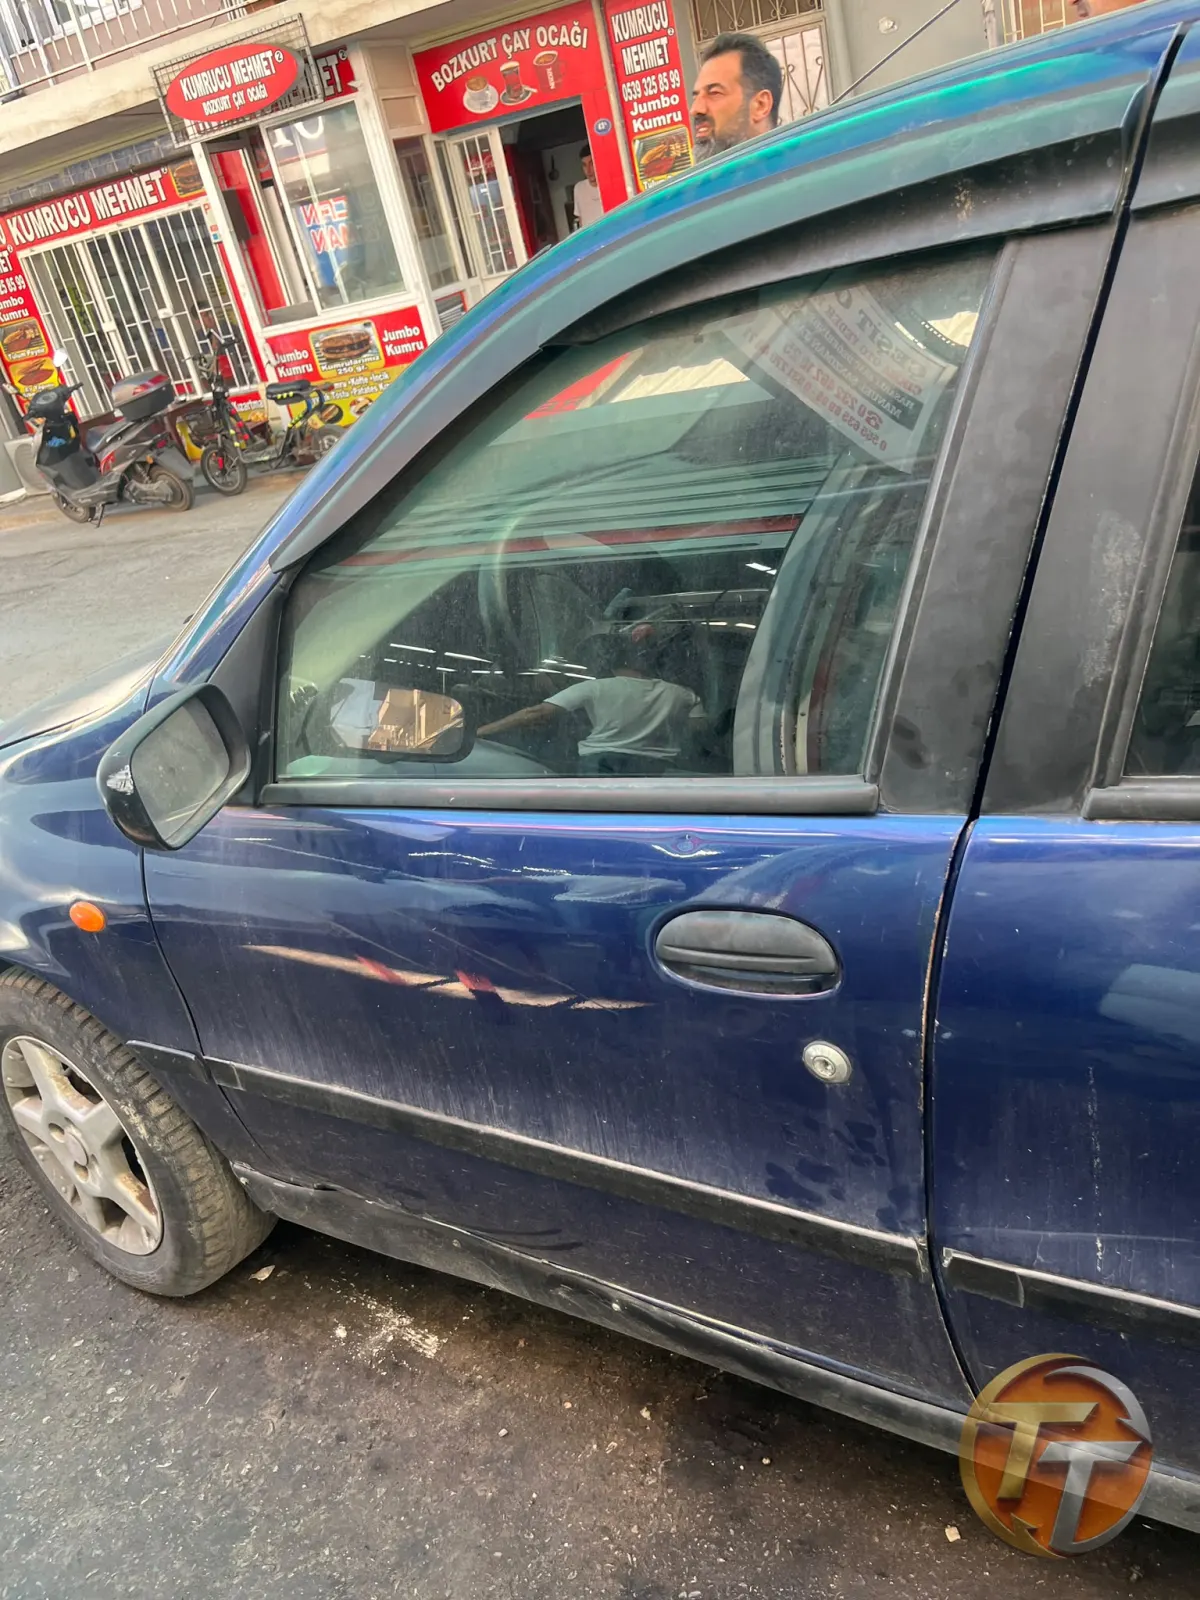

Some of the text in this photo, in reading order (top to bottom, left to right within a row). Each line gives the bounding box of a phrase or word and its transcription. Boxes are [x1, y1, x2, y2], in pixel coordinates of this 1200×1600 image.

[612, 1, 669, 43] KUMRUCU
[431, 21, 588, 92] BOZKURT ÇAY OCAĞI
[622, 36, 670, 76] MEHMET
[179, 66, 232, 101] KUMRUCU
[231, 50, 277, 85] MEHMET
[622, 69, 681, 102] 0539 325 85 99
[202, 82, 268, 116] BOZKURT ÇAY OCAĞI
[630, 93, 680, 116] Jumbo
[632, 110, 682, 133] Kumru
[6, 194, 91, 246] KUMRUCU
[88, 171, 168, 221] MEHMET
[382, 325, 420, 342] Jumbo
[275, 349, 309, 365] Jumbo
[386, 341, 424, 357] Kumru
[278, 365, 314, 379] Kumru
[337, 366, 354, 375] 250
